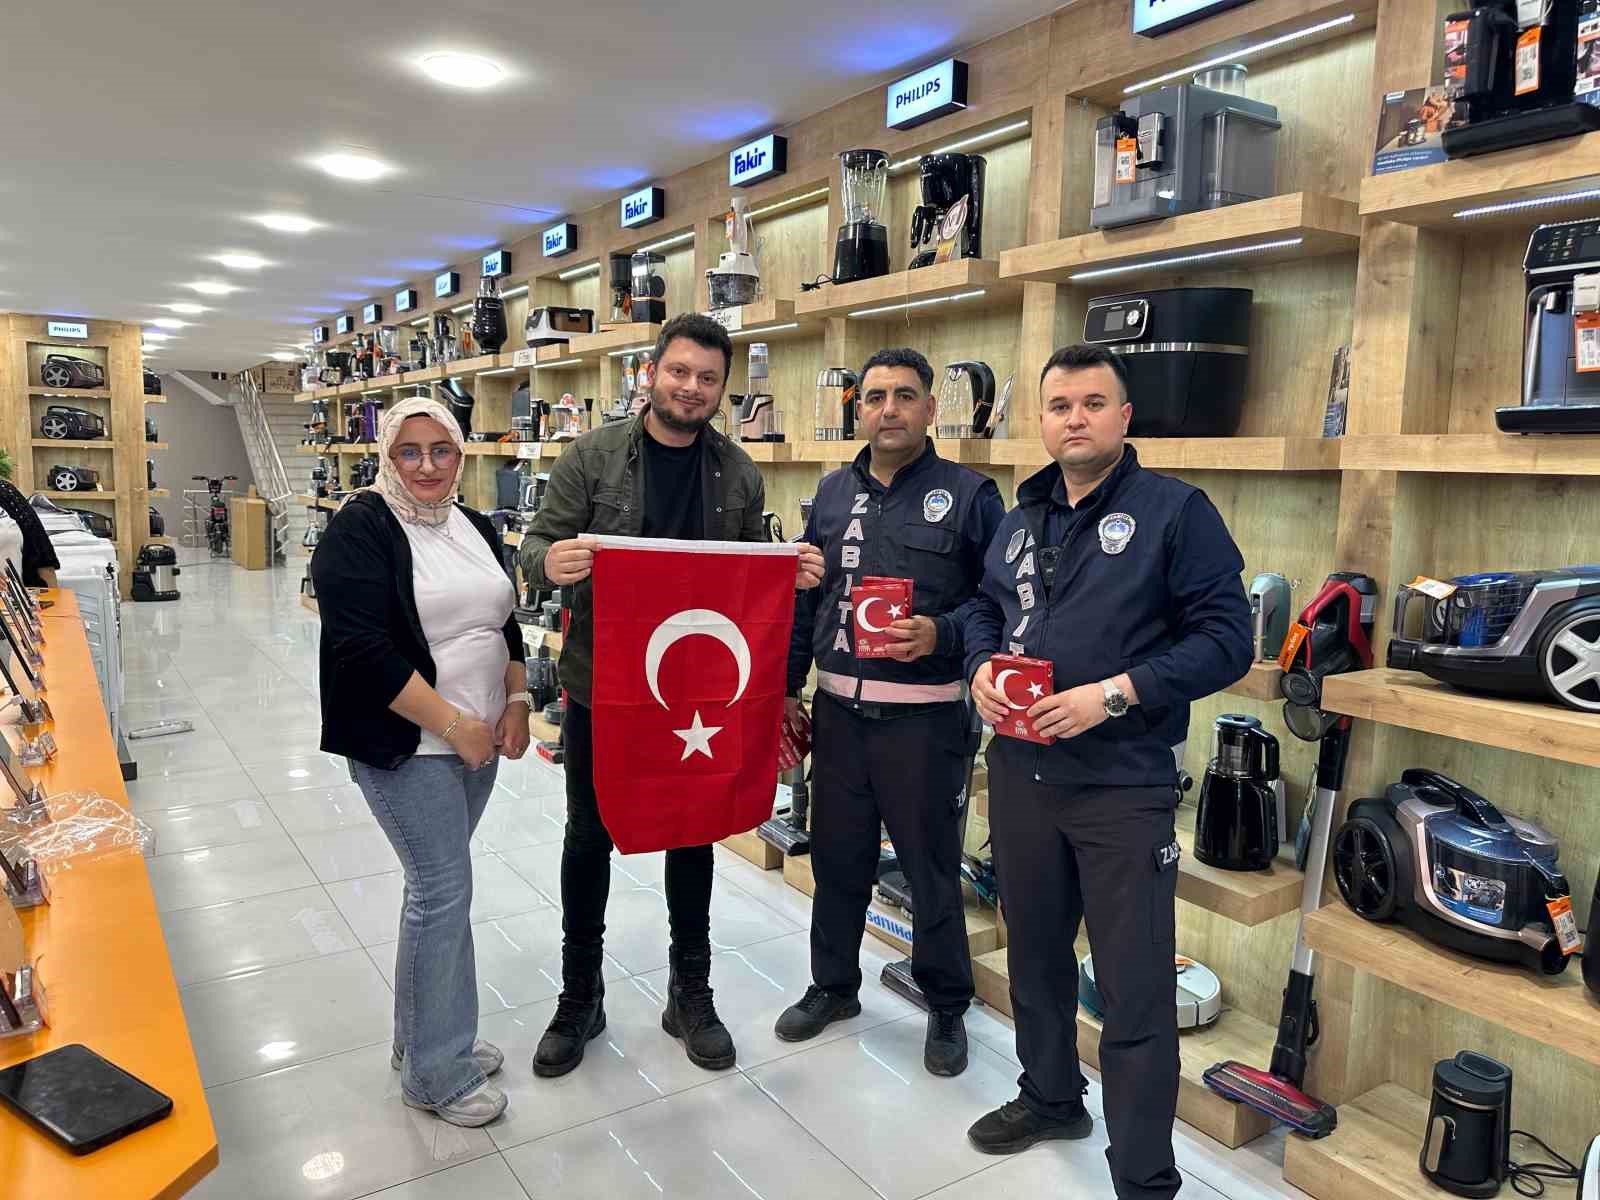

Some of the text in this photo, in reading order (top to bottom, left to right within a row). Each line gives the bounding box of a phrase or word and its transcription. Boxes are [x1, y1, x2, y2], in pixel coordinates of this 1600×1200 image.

[895, 78, 941, 109] PHILIPS
[734, 148, 767, 176] Fakir
[625, 198, 648, 220] Fakir
[832, 493, 870, 653] ZABITA
[866, 911, 912, 941] PHILIPS
